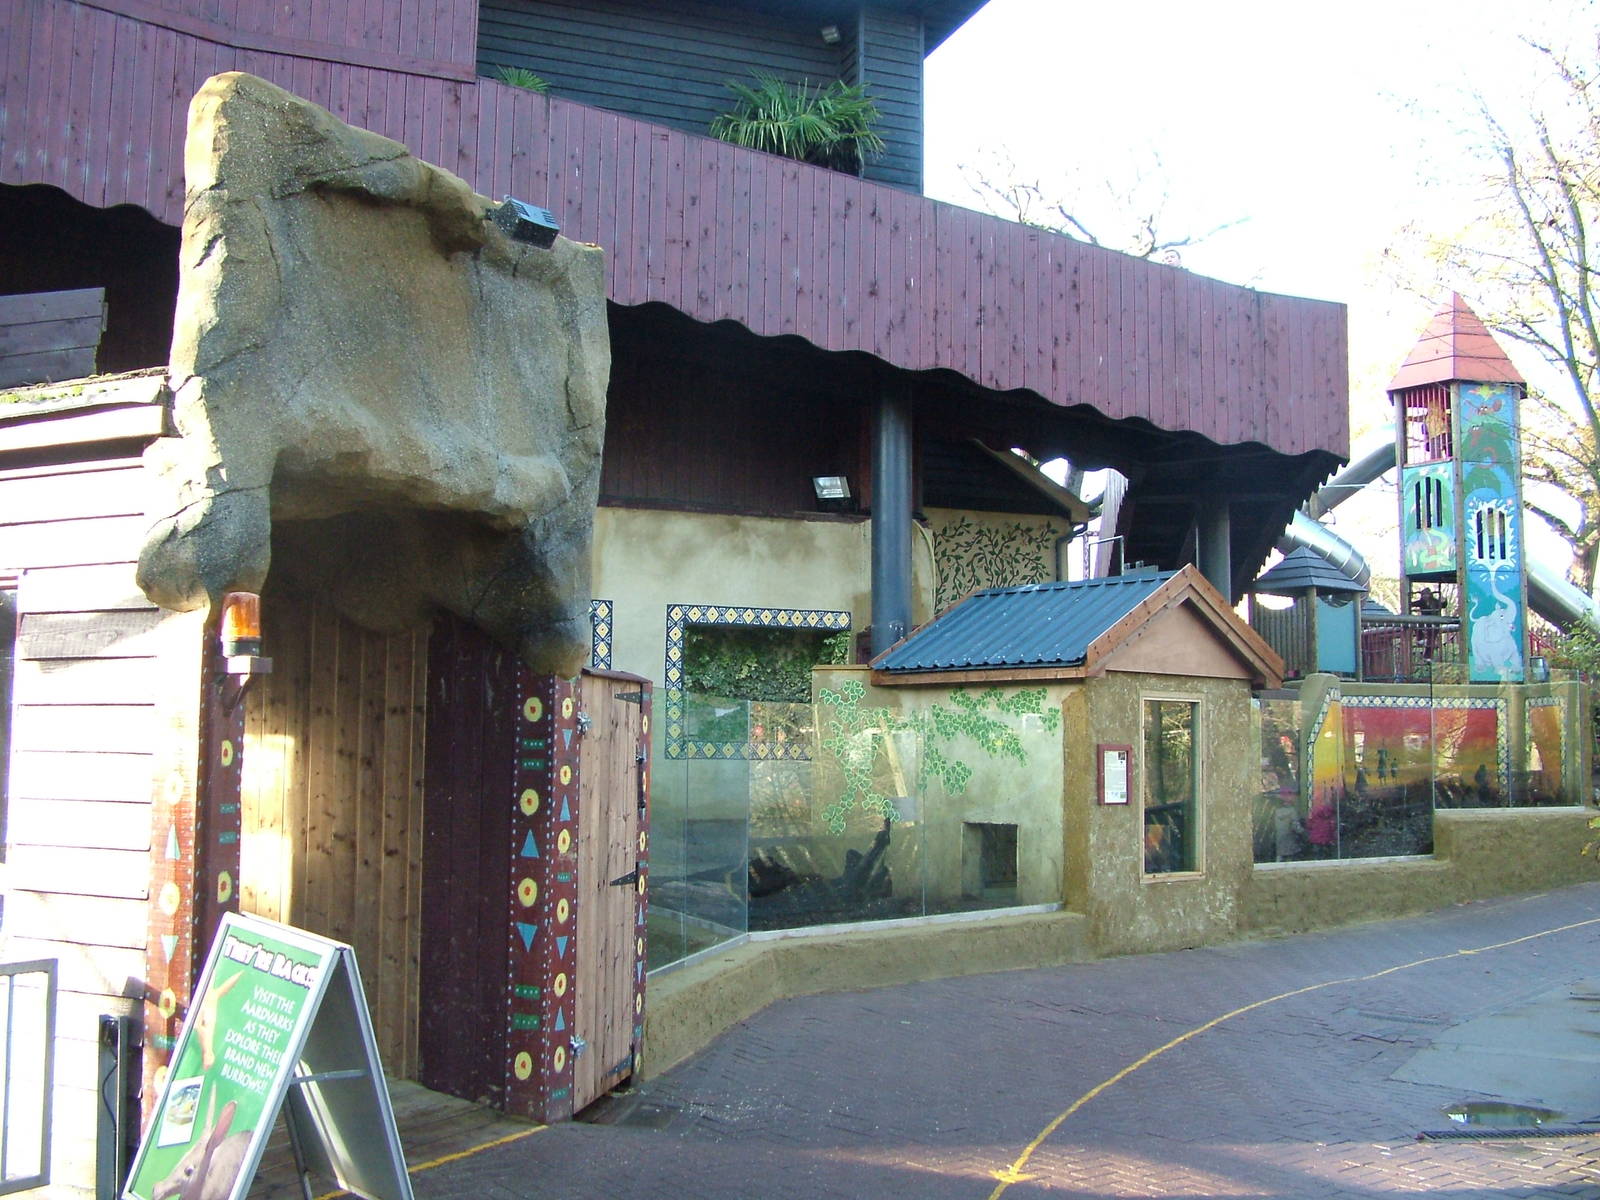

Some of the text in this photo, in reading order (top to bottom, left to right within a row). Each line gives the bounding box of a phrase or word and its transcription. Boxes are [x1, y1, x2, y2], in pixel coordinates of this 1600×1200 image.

[255, 986, 296, 1013] VISIT THE
[242, 1000, 294, 1031] AARDVARKS
[225, 1030, 262, 1054] EXPLORE
[244, 1021, 281, 1043] AS THEY
[225, 1048, 277, 1079] BRAND NEW
